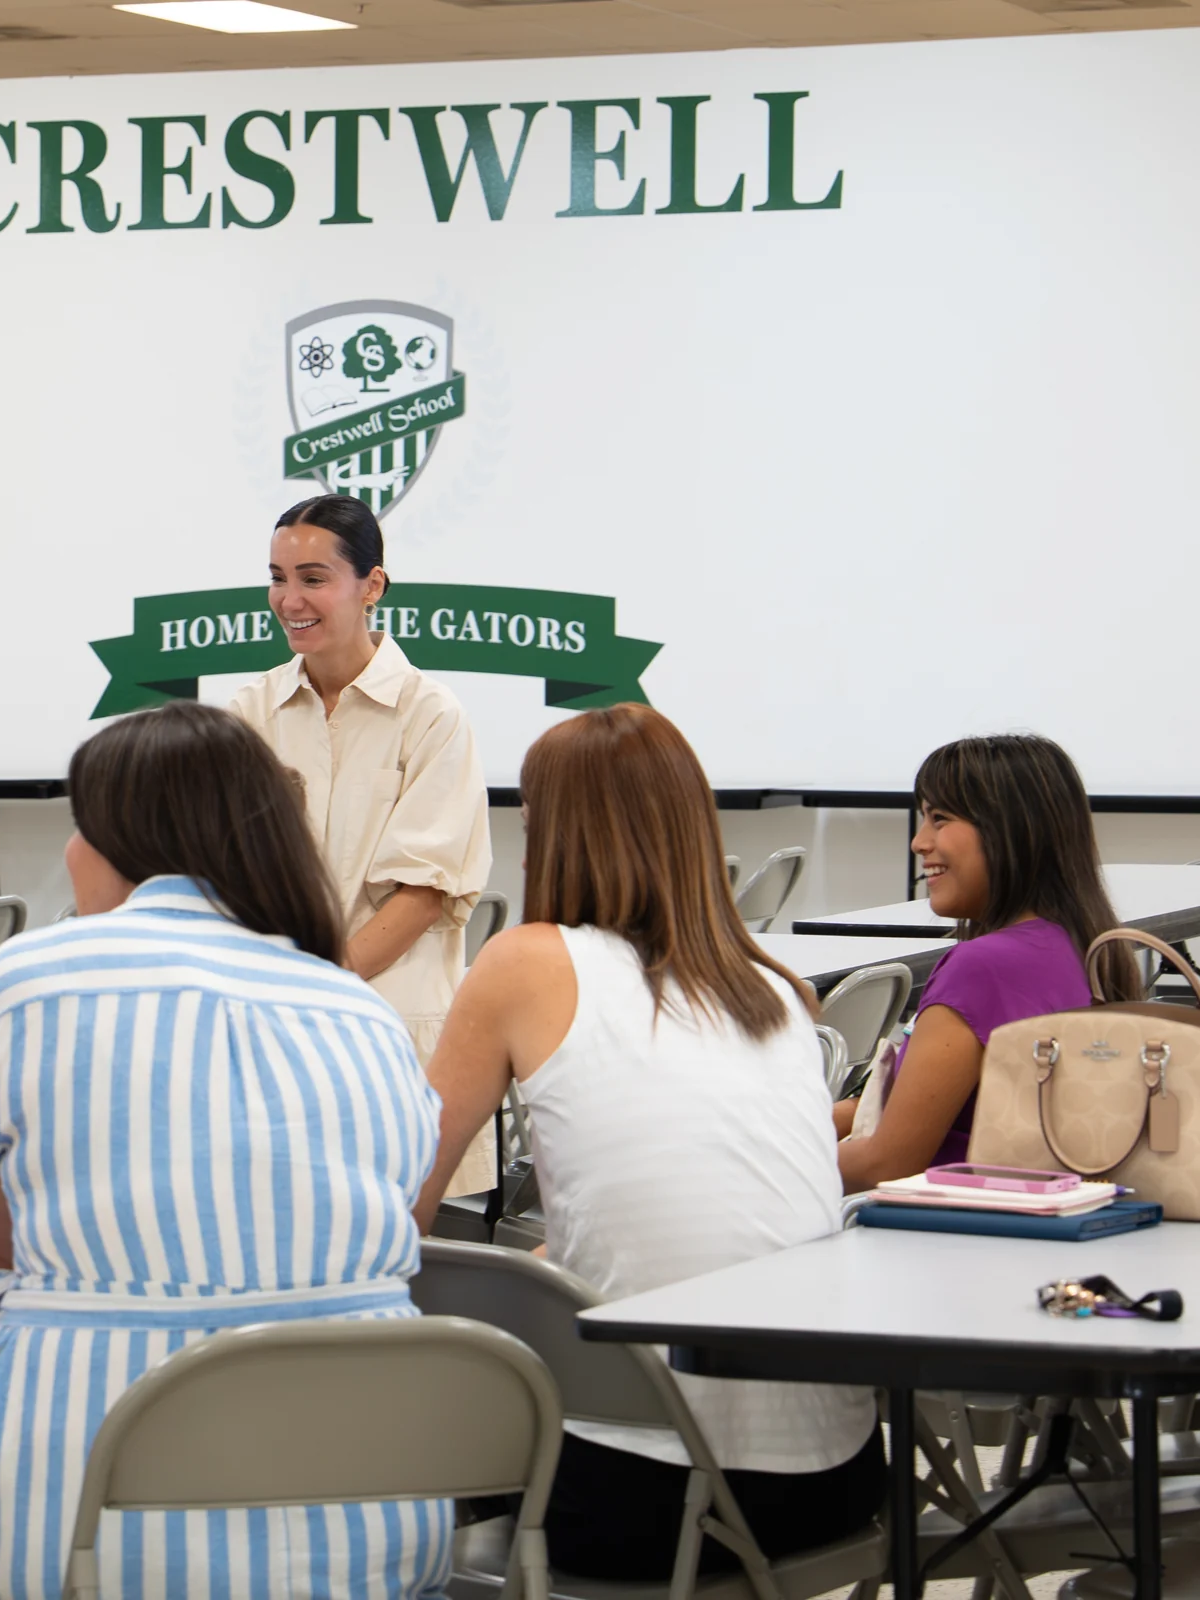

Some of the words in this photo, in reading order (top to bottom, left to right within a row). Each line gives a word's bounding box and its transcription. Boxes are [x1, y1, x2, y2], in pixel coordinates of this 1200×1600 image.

[292, 411, 384, 464] Crestwell
[387, 386, 456, 433] School
[159, 610, 274, 652] HOME
[367, 606, 421, 639] HE
[430, 608, 586, 653] GATORS
